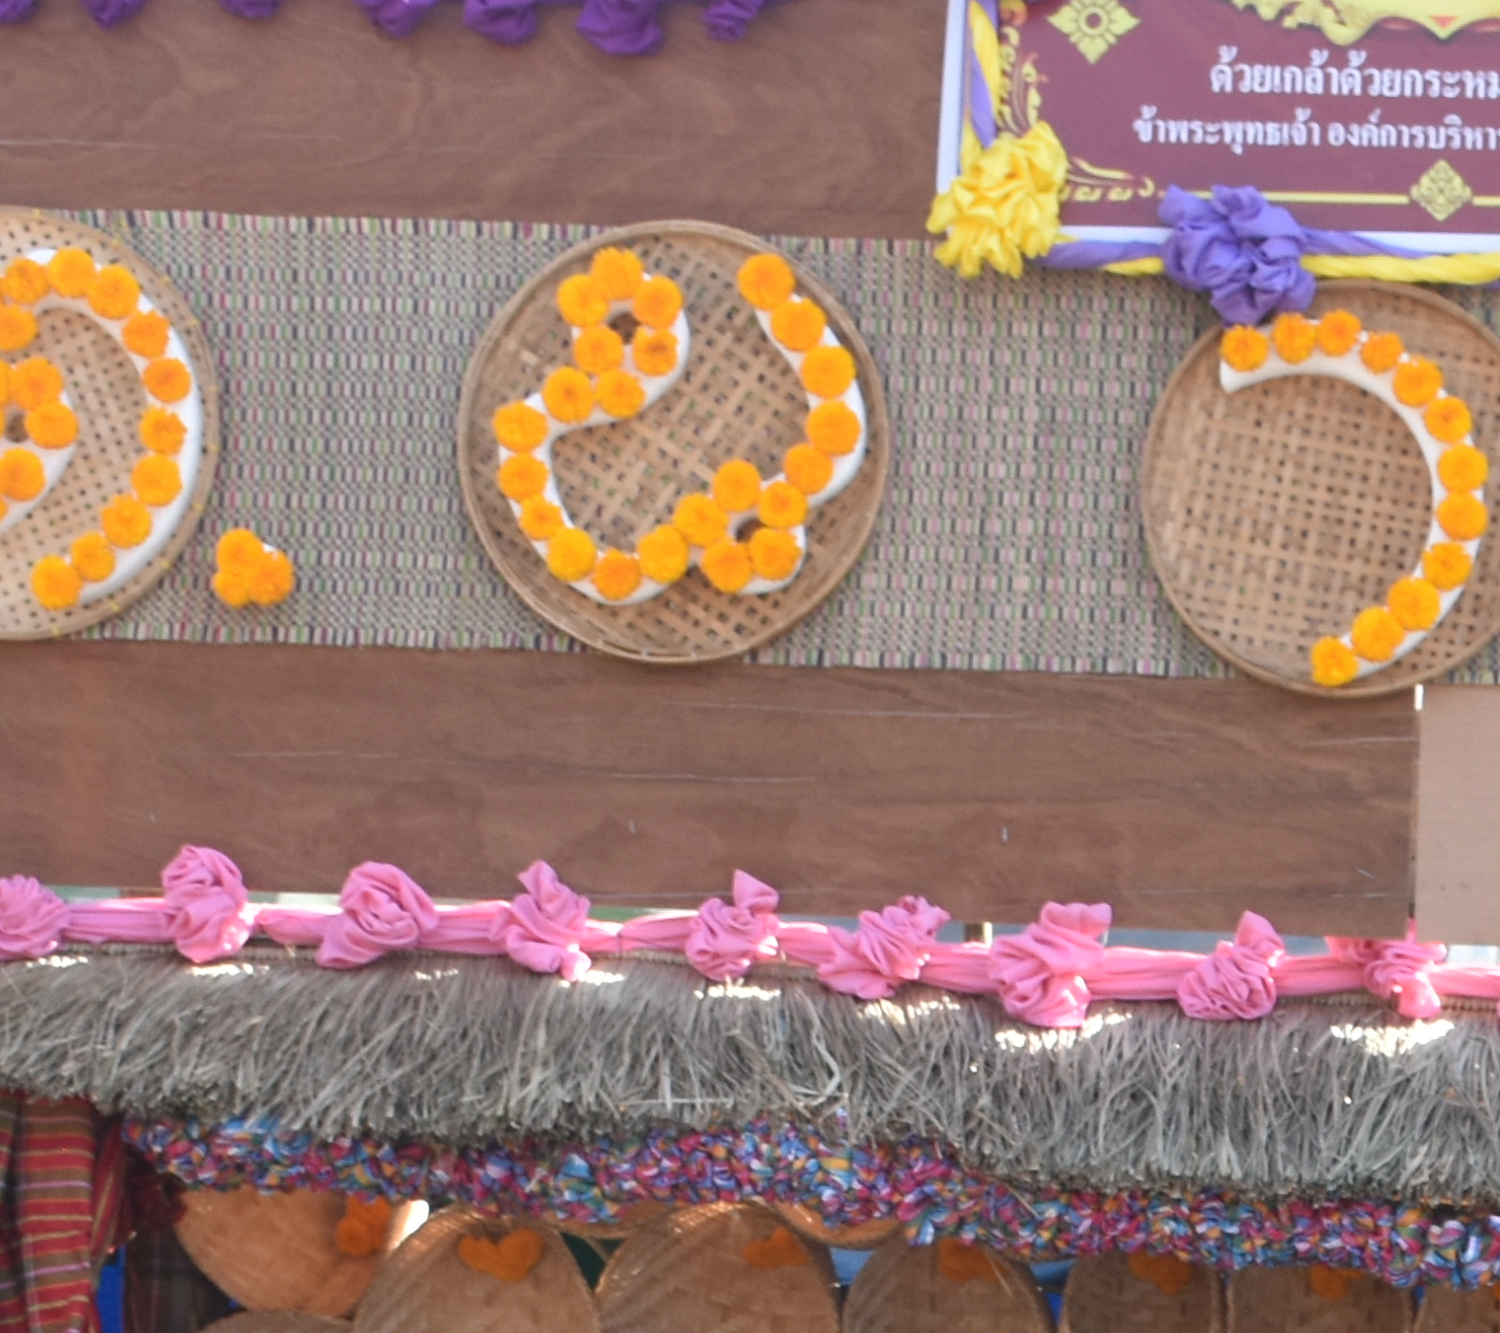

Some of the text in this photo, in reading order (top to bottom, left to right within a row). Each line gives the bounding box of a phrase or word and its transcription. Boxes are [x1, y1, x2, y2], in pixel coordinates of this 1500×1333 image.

[1132, 104, 1322, 155] ข้าพระพุทธเจ้า
